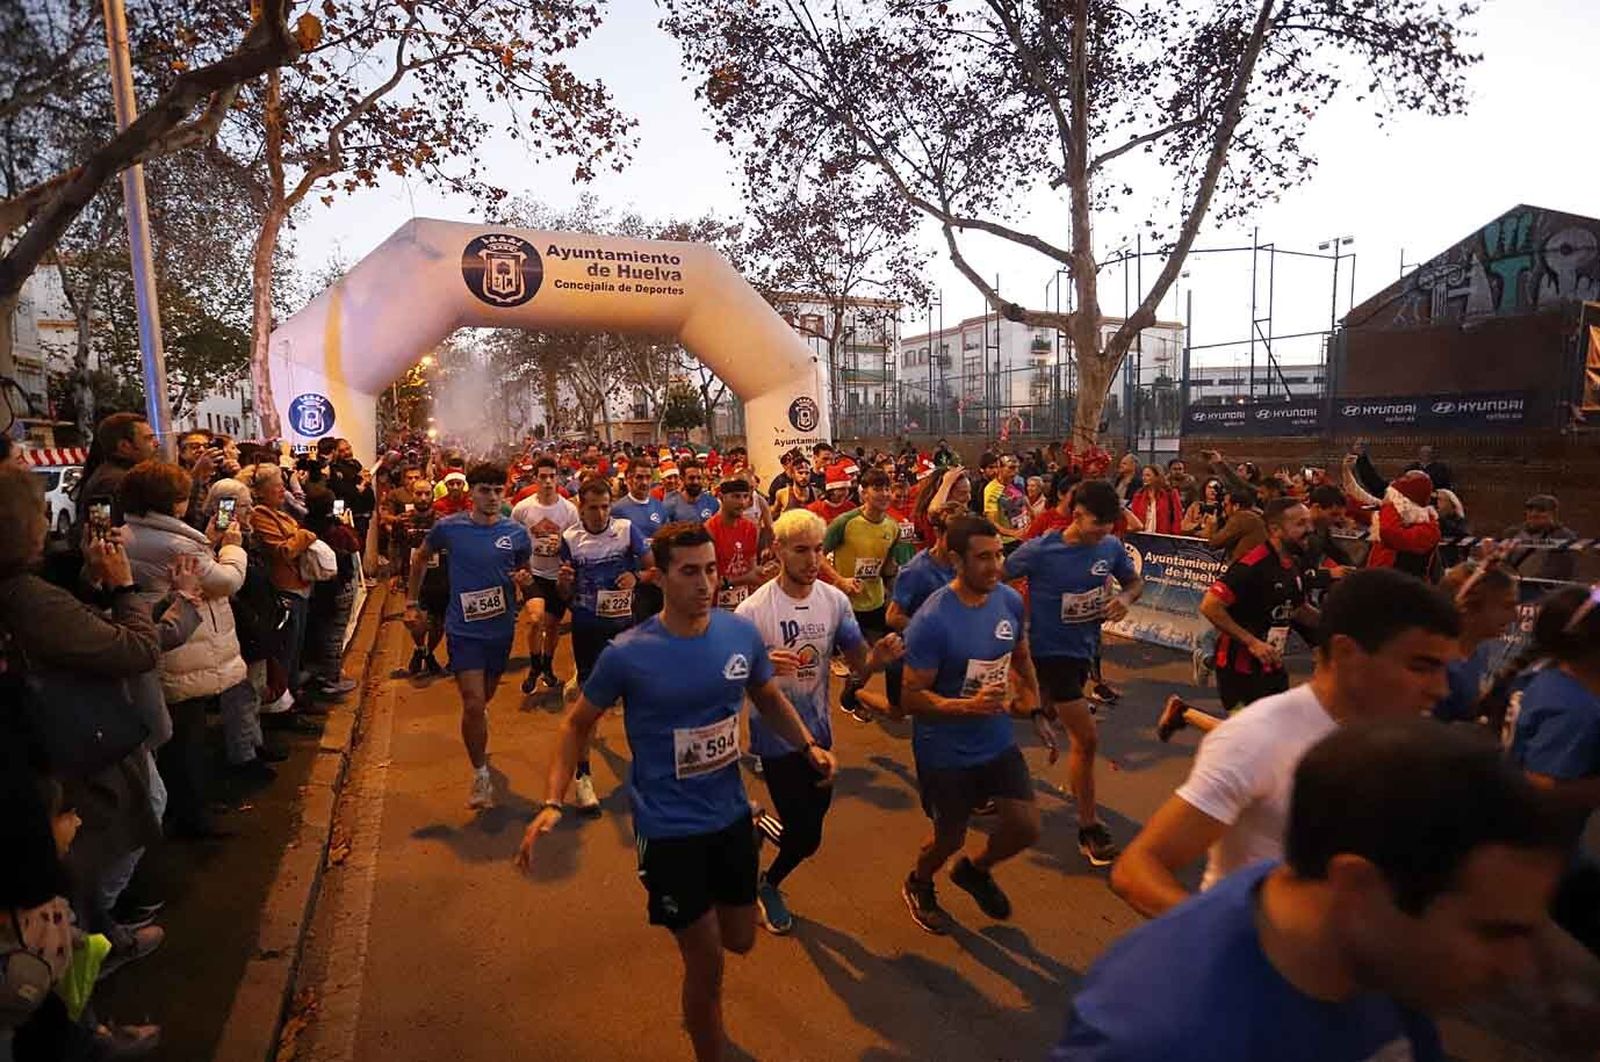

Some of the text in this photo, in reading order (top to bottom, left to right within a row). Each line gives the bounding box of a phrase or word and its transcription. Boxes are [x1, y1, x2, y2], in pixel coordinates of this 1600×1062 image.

[546, 245, 681, 265] Ayuntamiento
[587, 262, 682, 281] de Huelva
[618, 283, 632, 292] de
[635, 284, 685, 295] Deportes
[1363, 404, 1417, 415] HYUNDAI
[1458, 400, 1524, 412] HYUNDAI
[1207, 411, 1246, 419] HYUNDAI
[1273, 408, 1317, 418] HYUNDAI
[1144, 552, 1229, 573] Ayuntamiento
[1165, 566, 1216, 583] de Huel
[480, 596, 501, 611] 548
[612, 598, 629, 609] 229
[705, 730, 735, 758] 594
